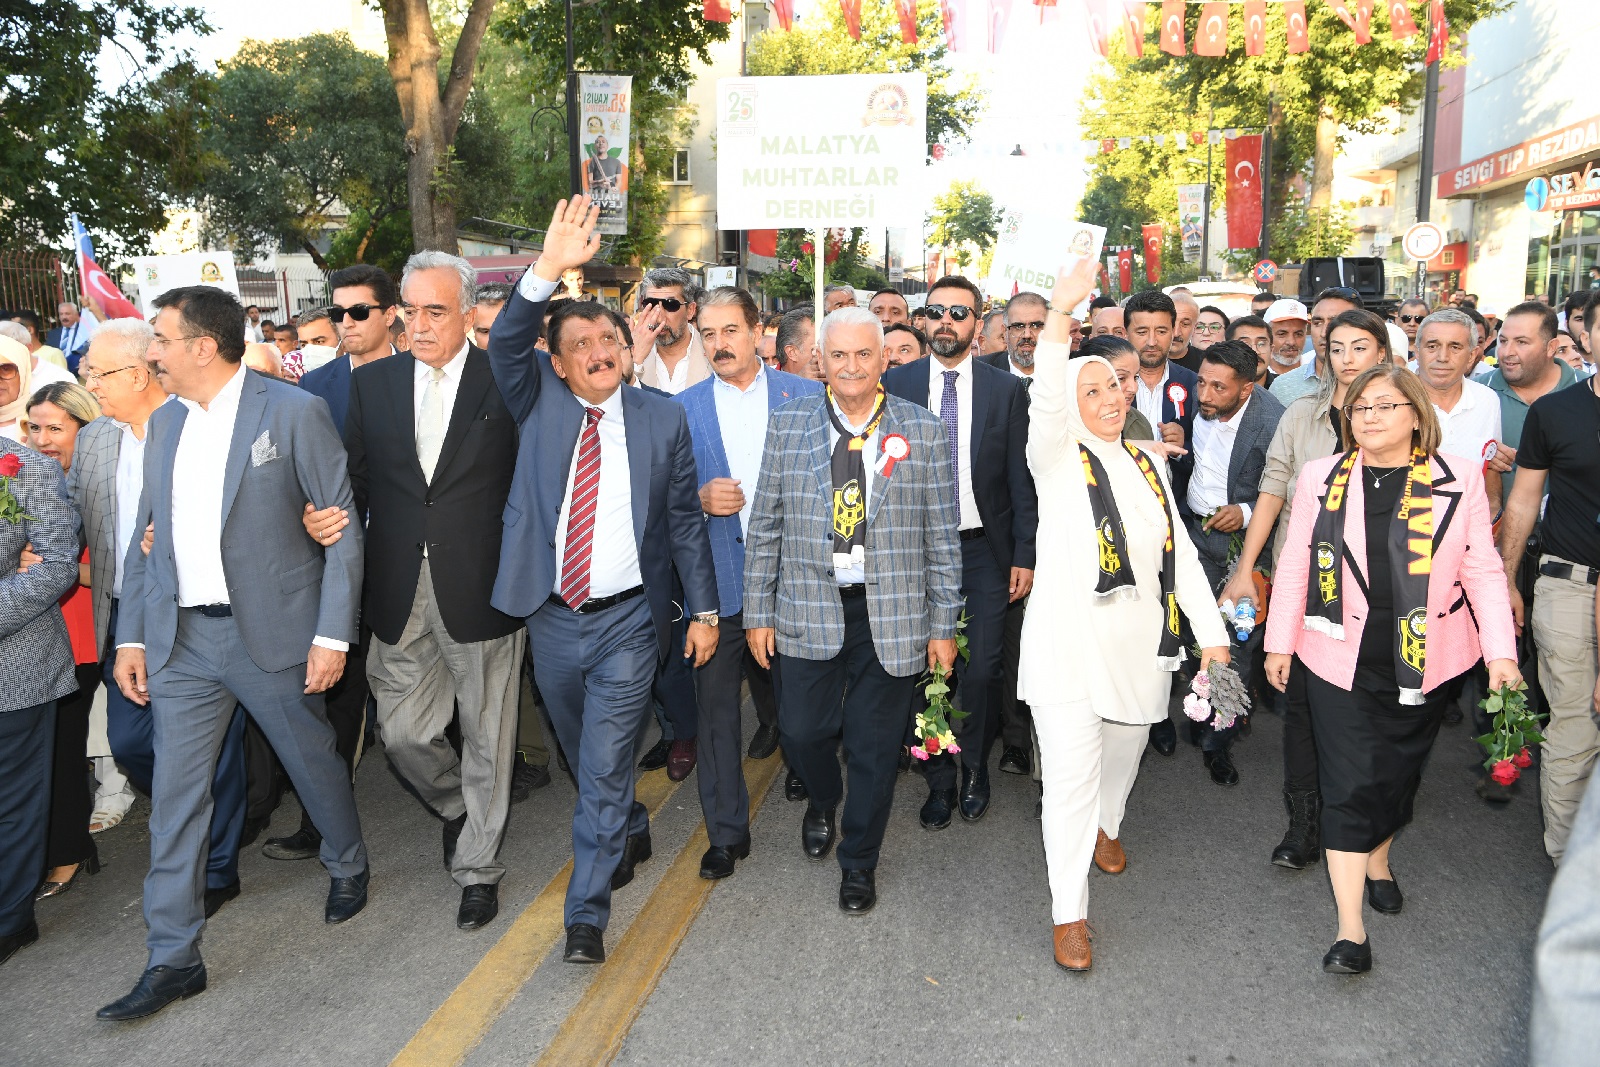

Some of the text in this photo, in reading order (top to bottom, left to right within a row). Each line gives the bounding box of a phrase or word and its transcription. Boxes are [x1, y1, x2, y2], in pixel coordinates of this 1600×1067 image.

[728, 91, 753, 120] 25
[761, 134, 881, 155] MALATYA
[1454, 120, 1600, 190] SEVGİ TIP REZİDA
[742, 166, 899, 187] MUHTARLAR
[1550, 161, 1600, 196] SEVG
[765, 193, 875, 218] DERNEĞİ
[1550, 197, 1565, 208] TIP
[1408, 645, 1426, 657] MALA
